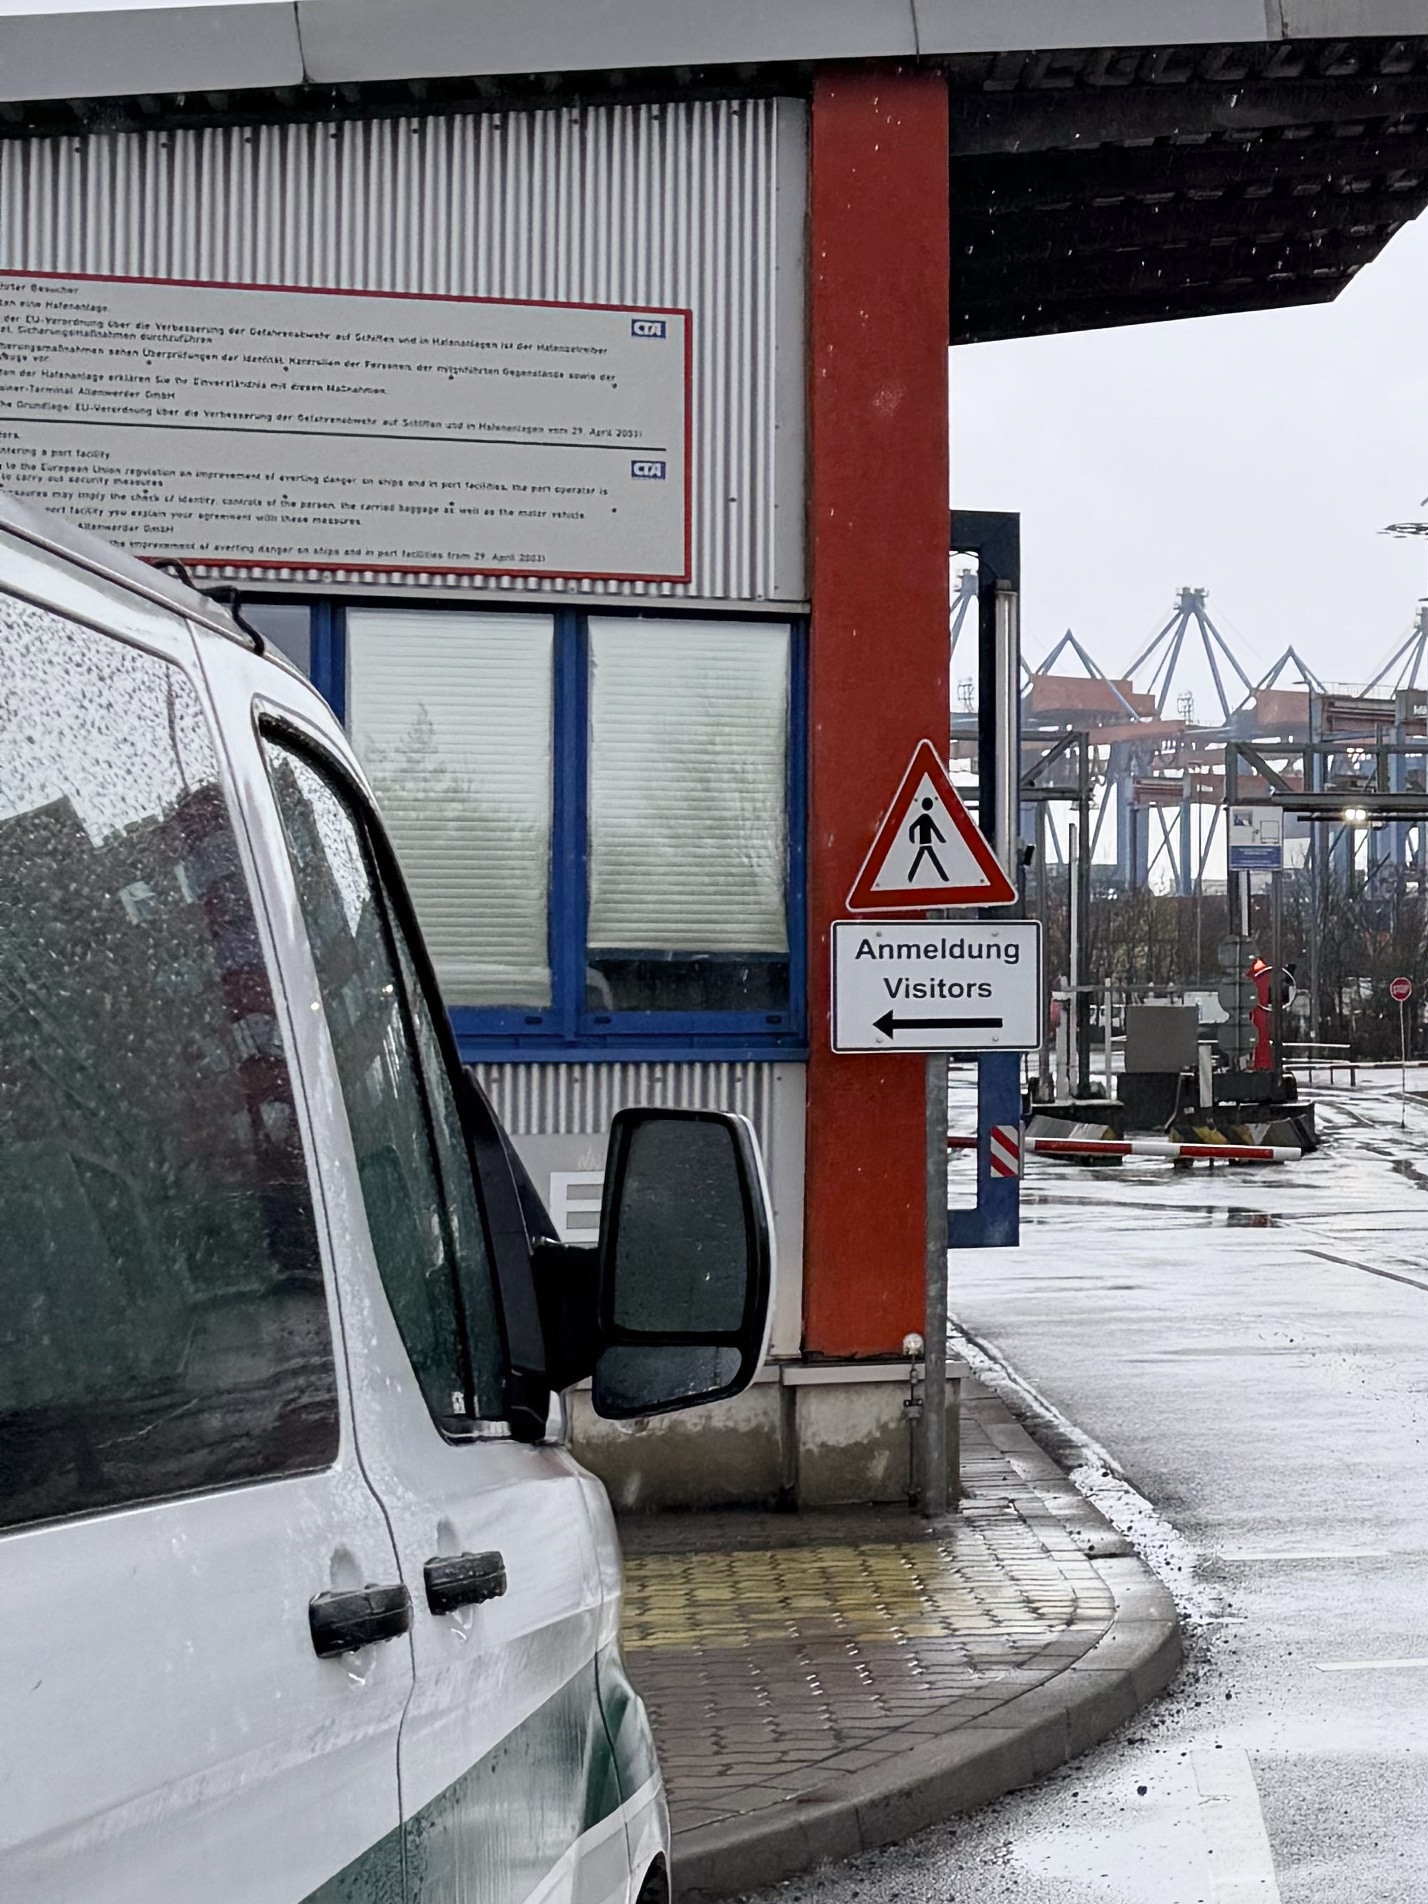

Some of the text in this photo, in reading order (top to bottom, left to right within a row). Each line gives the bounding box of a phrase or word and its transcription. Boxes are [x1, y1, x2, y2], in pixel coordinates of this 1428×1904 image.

[633, 321, 662, 336] CTA
[633, 462, 662, 477] CTA
[854, 938, 1020, 965] Anmeldung
[883, 977, 993, 999] Visitors
